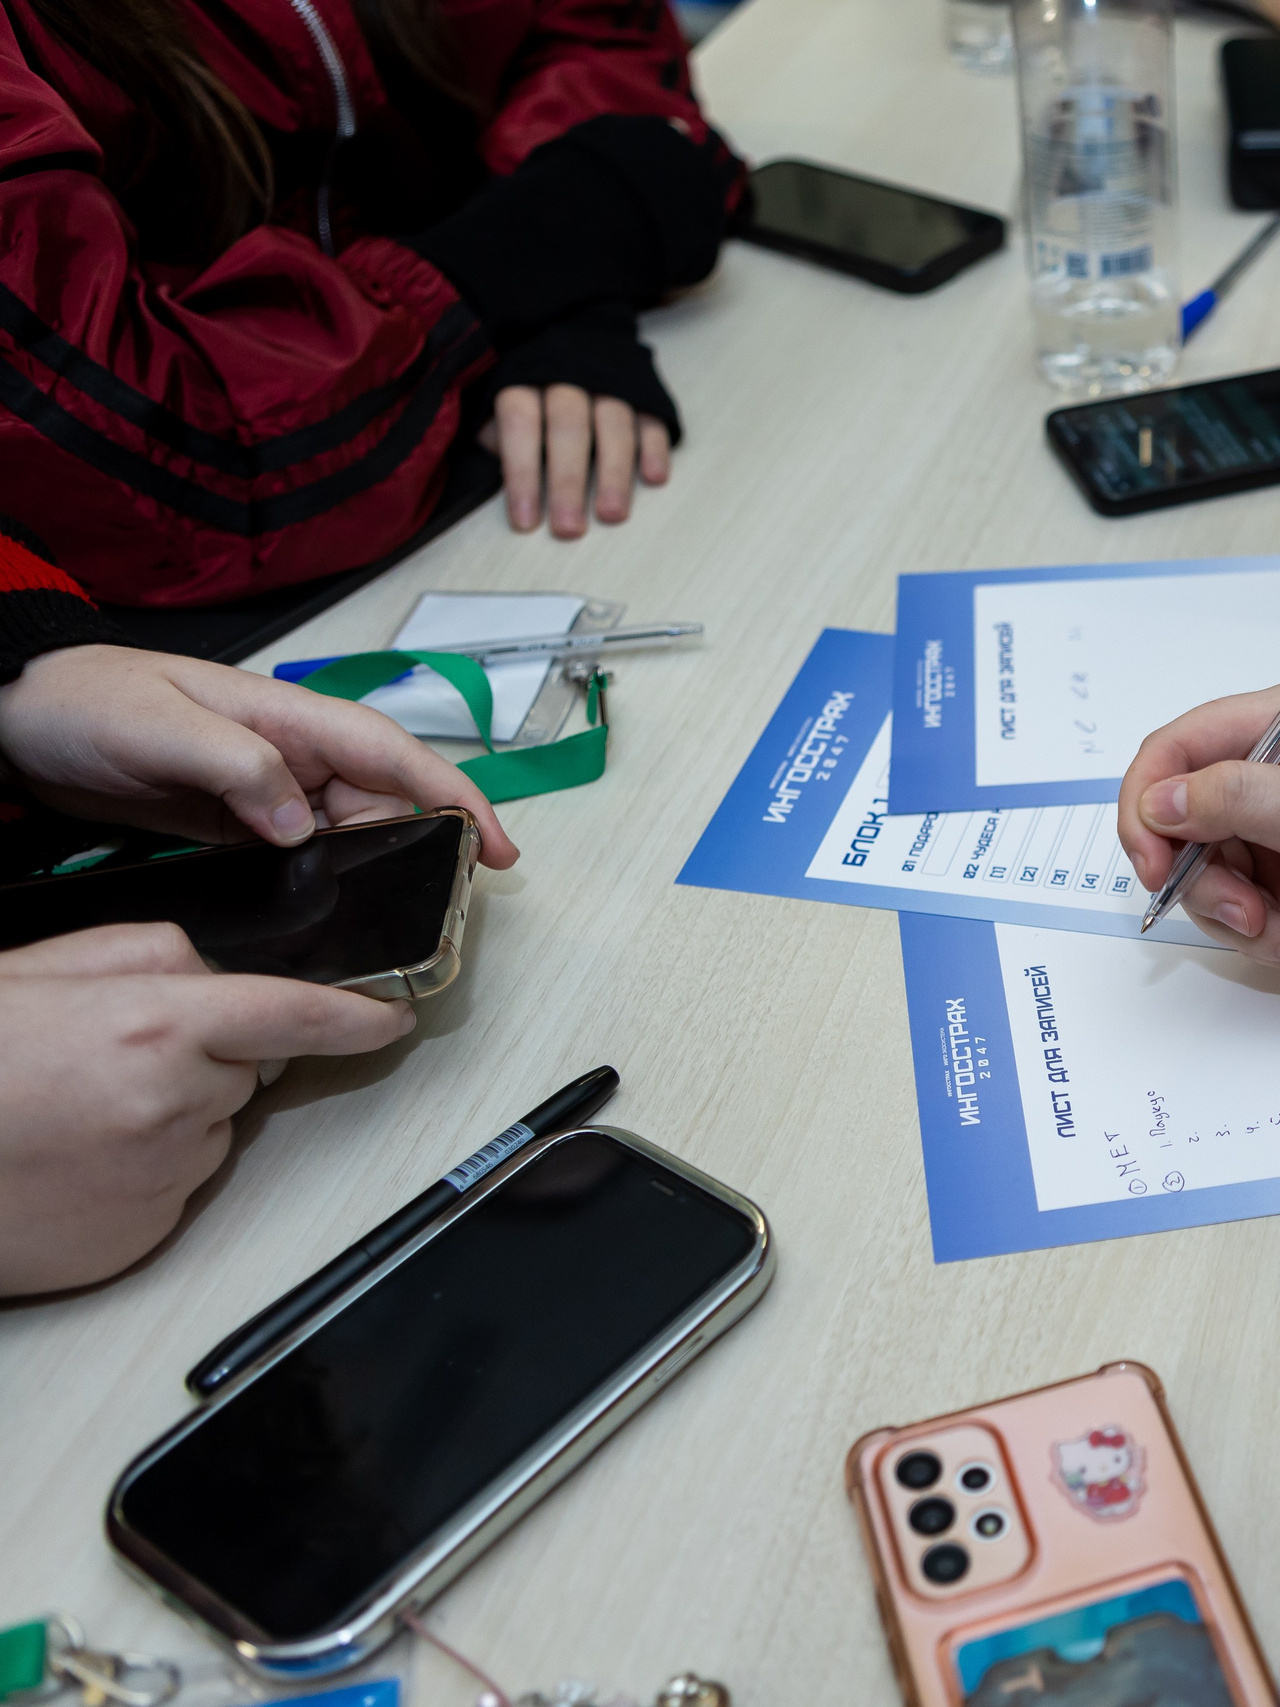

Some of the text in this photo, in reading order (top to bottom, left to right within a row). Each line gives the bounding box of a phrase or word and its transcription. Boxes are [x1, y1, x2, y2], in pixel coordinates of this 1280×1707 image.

[763, 691, 855, 823] ИНГОССТРАХ
[815, 735, 849, 781] 2047
[842, 812, 888, 867] БЛОК
[909, 811, 942, 857] ПОДАРО
[971, 817, 1000, 860] ЧУДЕСА
[945, 998, 981, 1126] ИНГОССТРАХ
[974, 1036, 991, 1080] 2047
[1023, 965, 1076, 1139] ЛИСТ ДЛЯ ЗАПИСЕЙ
